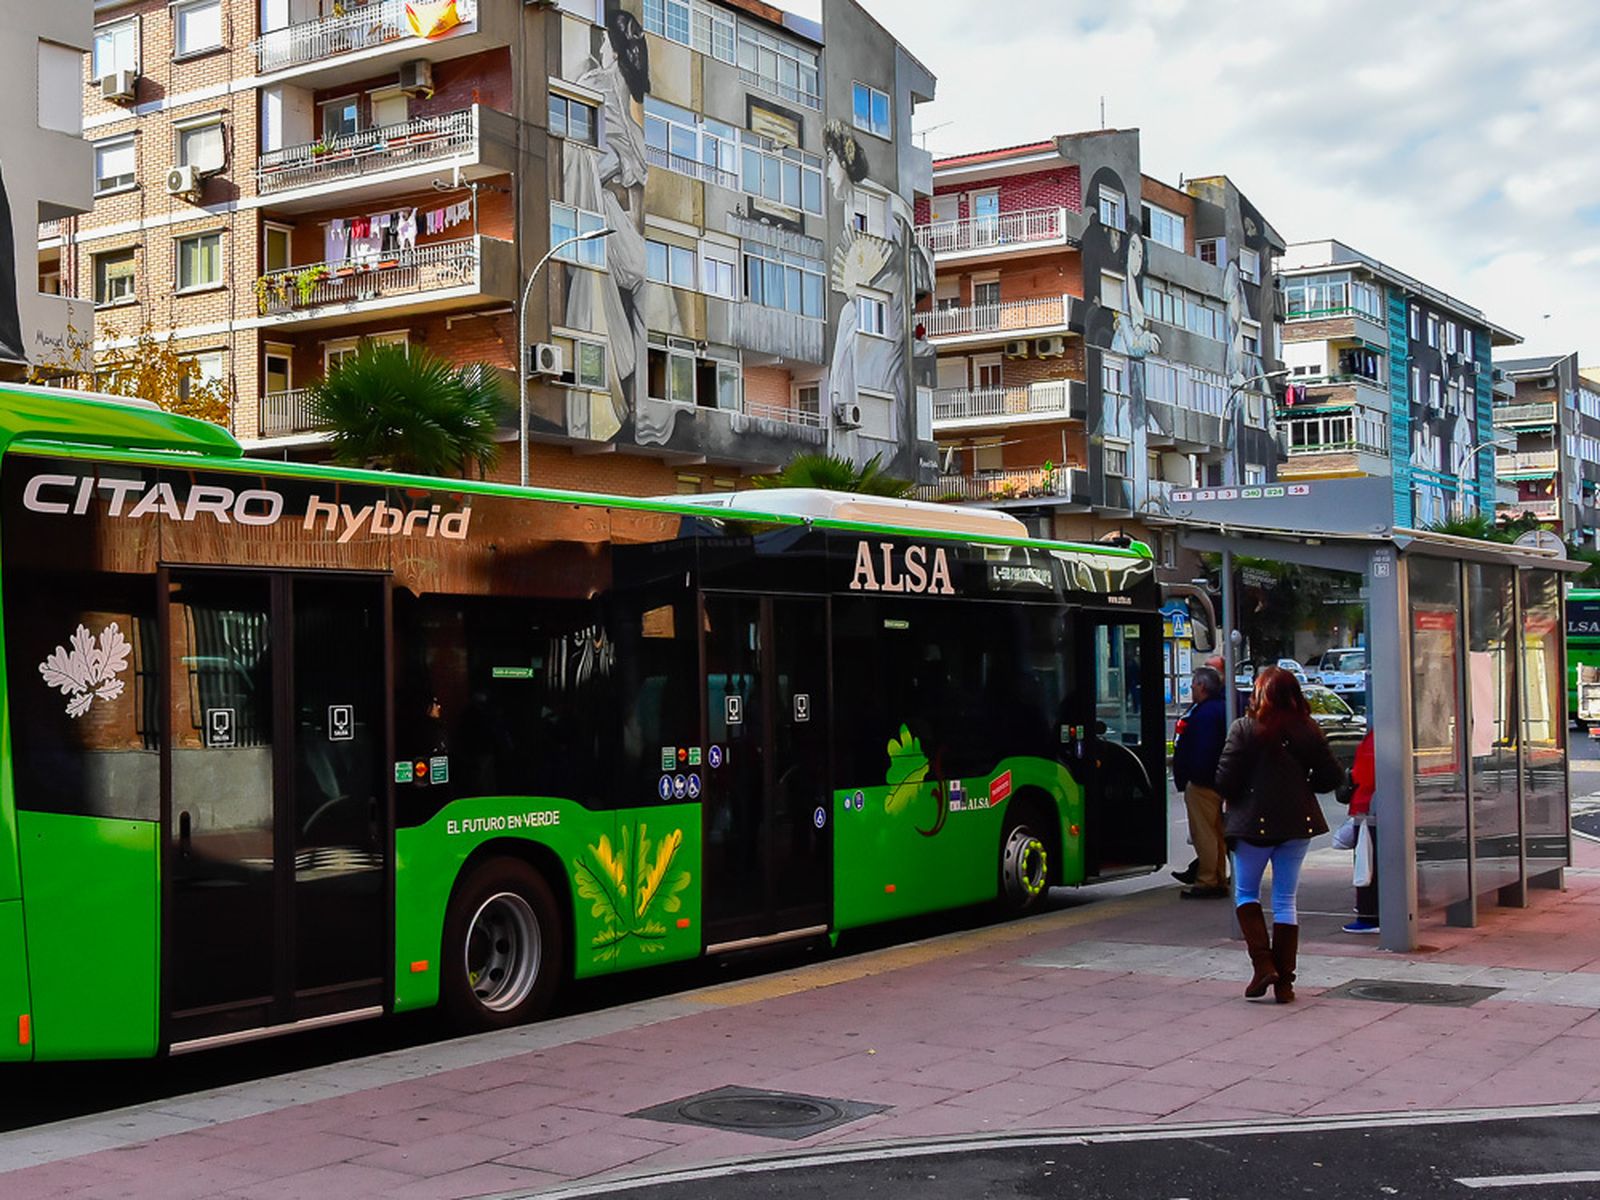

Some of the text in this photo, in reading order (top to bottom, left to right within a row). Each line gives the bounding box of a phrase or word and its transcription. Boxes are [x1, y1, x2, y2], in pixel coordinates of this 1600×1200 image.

[23, 474, 472, 543] CITARO hybrid
[849, 541, 955, 594] ALSA
[1568, 621, 1600, 632] LSA
[967, 797, 991, 810] ALSA
[447, 820, 460, 834] EL
[462, 816, 505, 833] FUTURO
